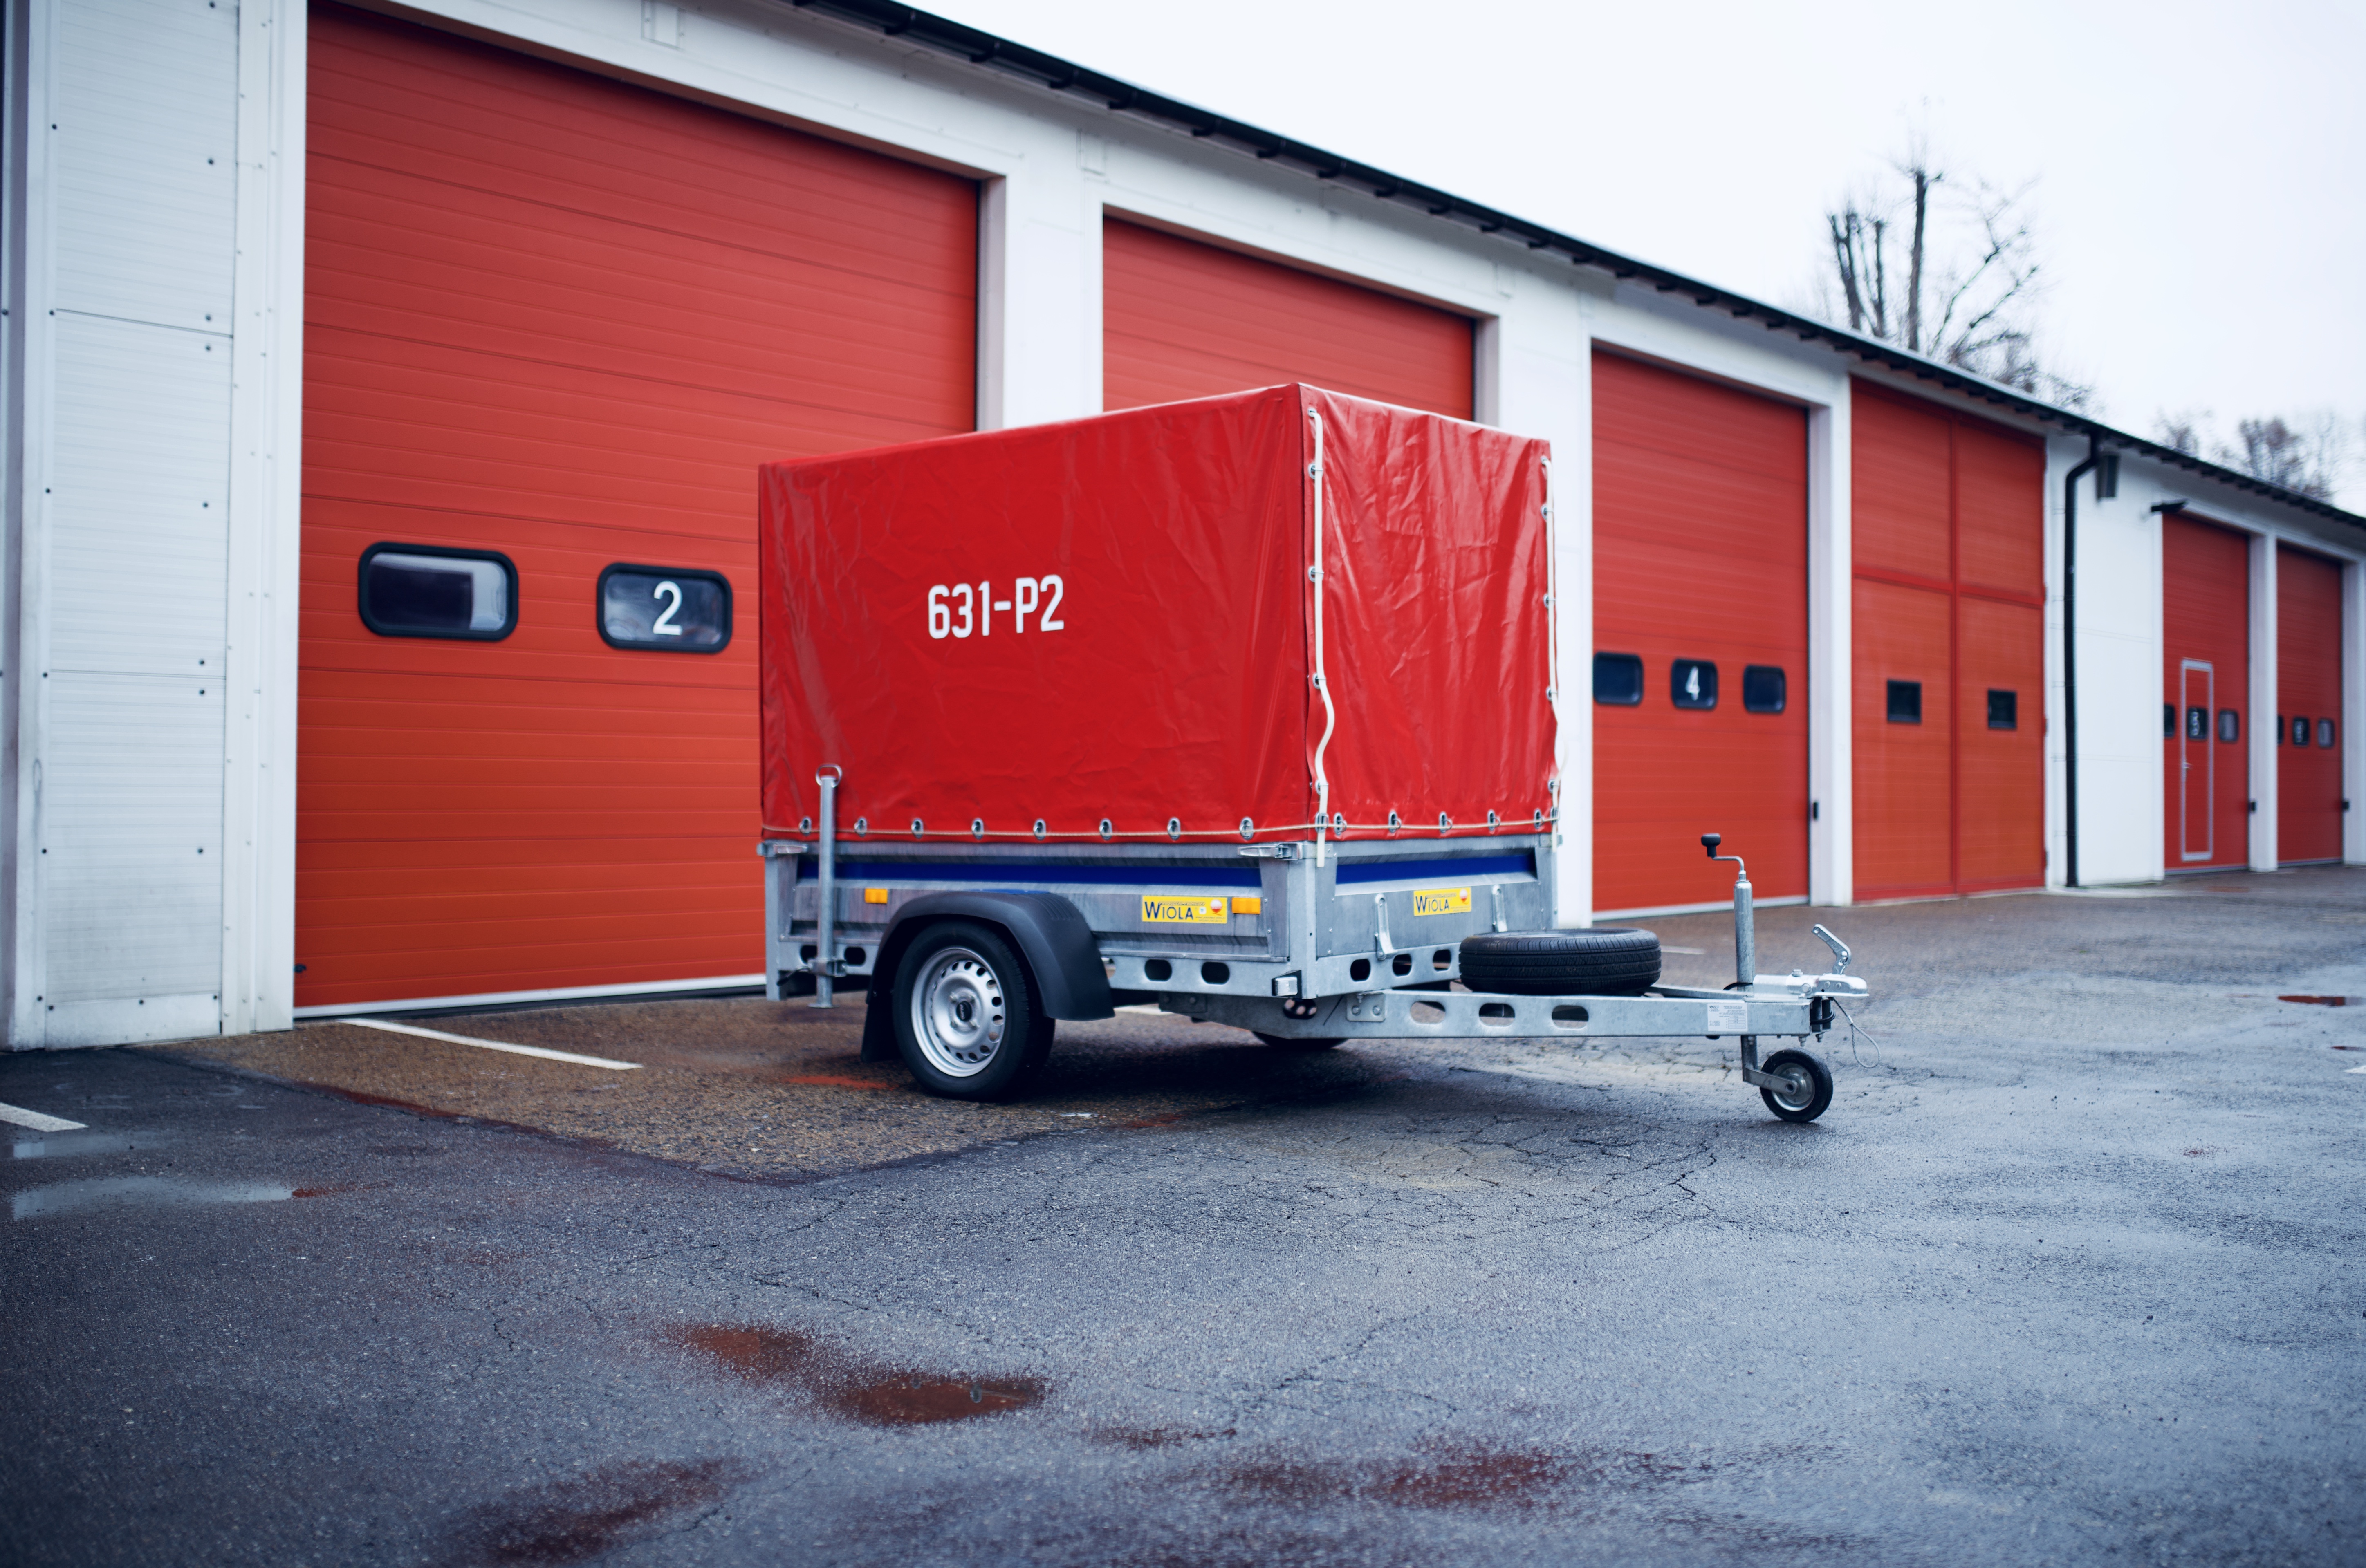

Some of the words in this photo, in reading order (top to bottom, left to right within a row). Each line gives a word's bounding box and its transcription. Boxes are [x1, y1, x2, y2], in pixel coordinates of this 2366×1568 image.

[653, 580, 682, 636] 2
[928, 574, 1064, 639] 631-P2
[1685, 666, 1700, 701] 4
[1144, 901, 1194, 920] WIOLA
[1415, 895, 1450, 913] WIOLA
